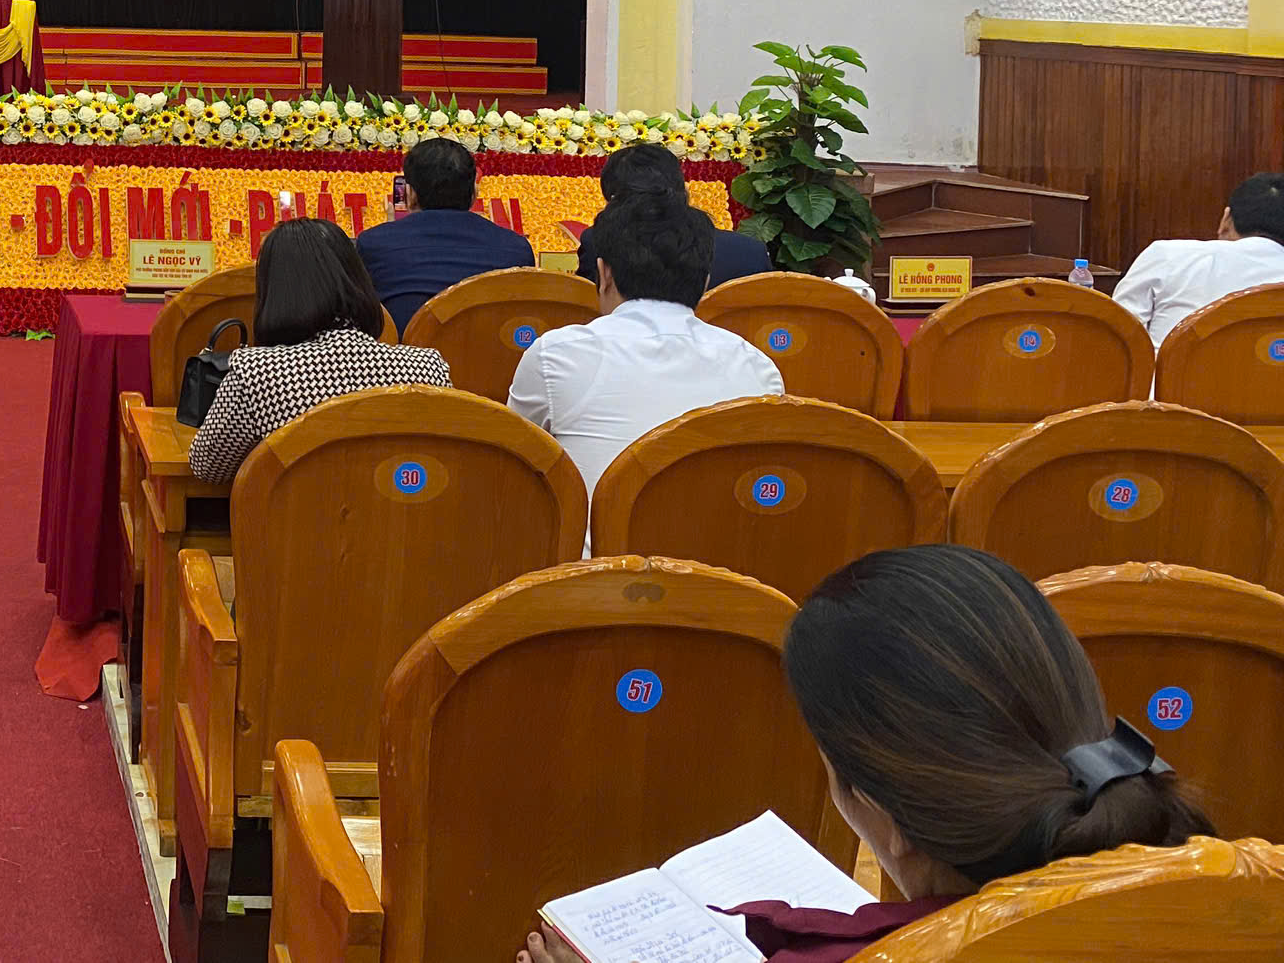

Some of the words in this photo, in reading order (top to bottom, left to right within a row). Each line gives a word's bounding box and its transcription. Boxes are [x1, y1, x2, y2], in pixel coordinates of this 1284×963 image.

[33, 159, 113, 260] ĐỔI
[126, 170, 213, 245] MỚI
[143, 254, 155, 265] LÊ
[157, 256, 186, 267] NGỌC
[898, 272, 909, 284] LÊ
[934, 275, 963, 284] PHONG
[519, 331, 532, 343] 12
[774, 334, 788, 346] 13
[400, 468, 421, 487] 30
[759, 482, 779, 500] 29
[1111, 486, 1132, 504] 28
[627, 679, 654, 704] 51
[1157, 697, 1184, 721] 52
